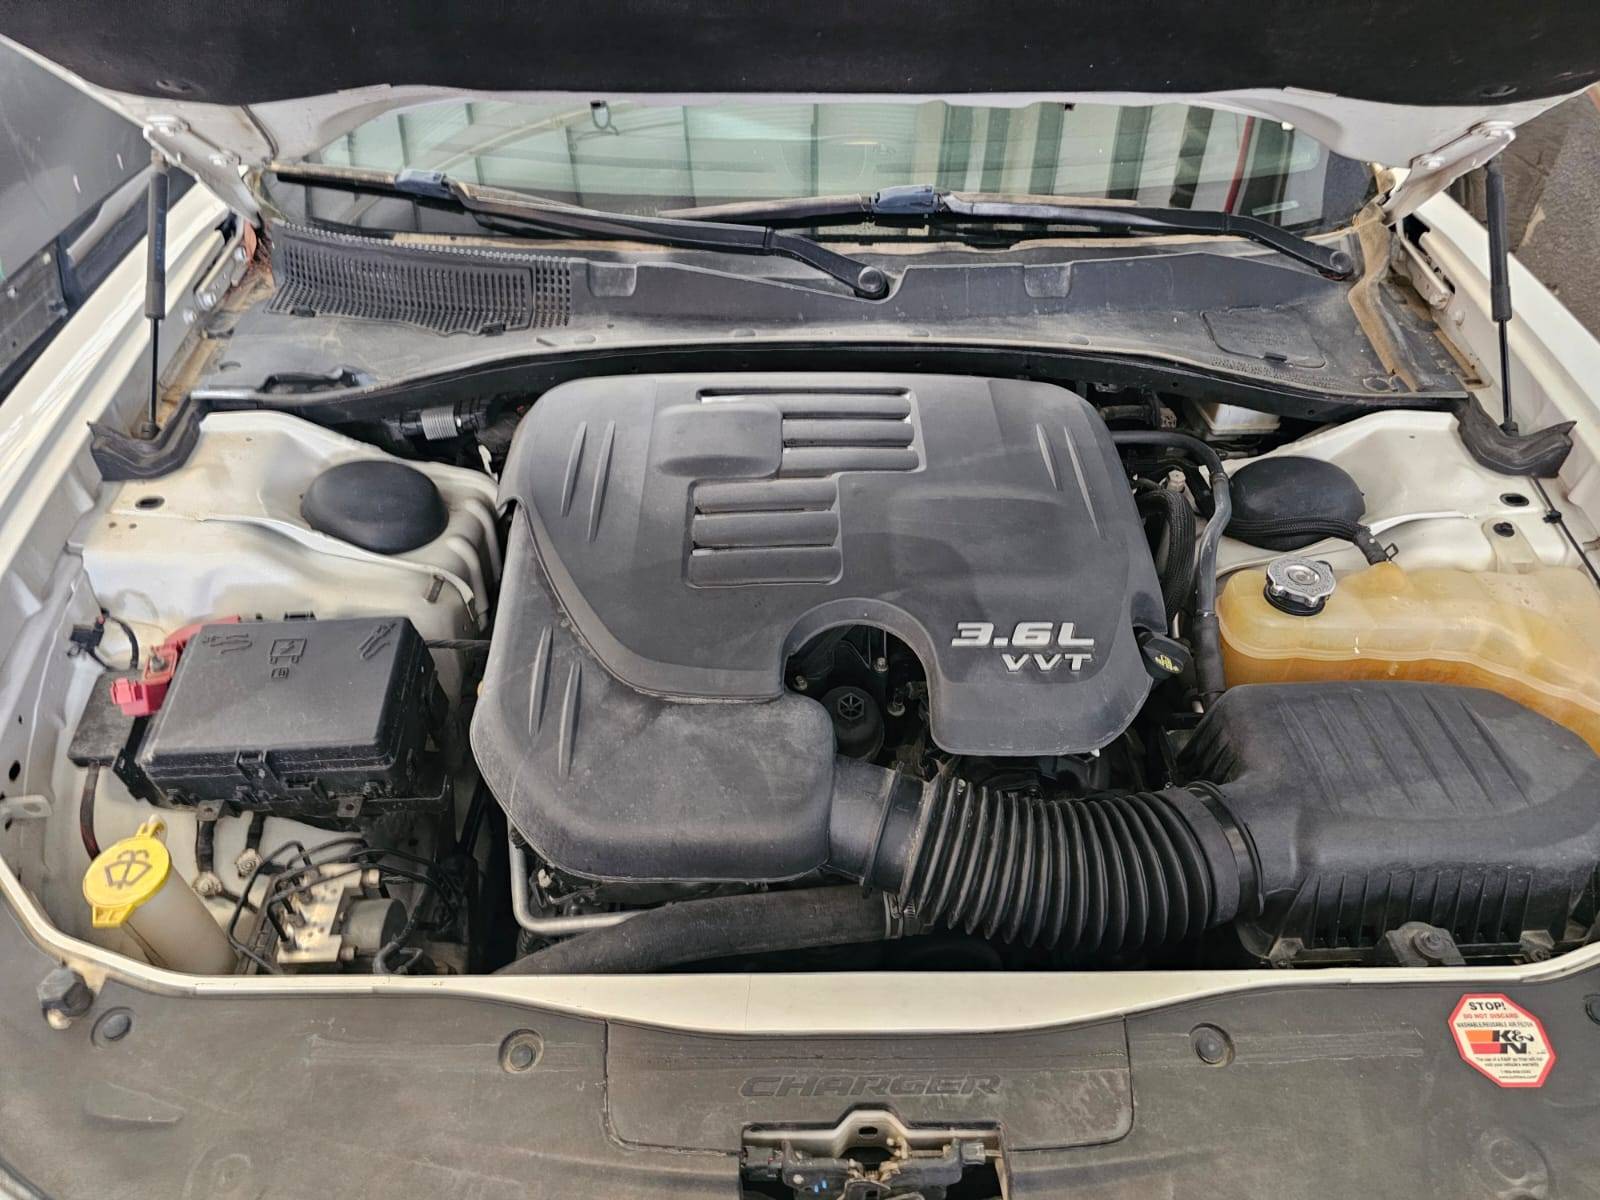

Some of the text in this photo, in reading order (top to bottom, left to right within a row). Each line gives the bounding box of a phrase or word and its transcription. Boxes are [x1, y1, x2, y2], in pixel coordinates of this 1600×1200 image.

[952, 622, 1095, 647] 3.6L
[1001, 653, 1094, 672] VVT
[1469, 1001, 1507, 1011] STOP!
[739, 1074, 1002, 1098] CHARGER
